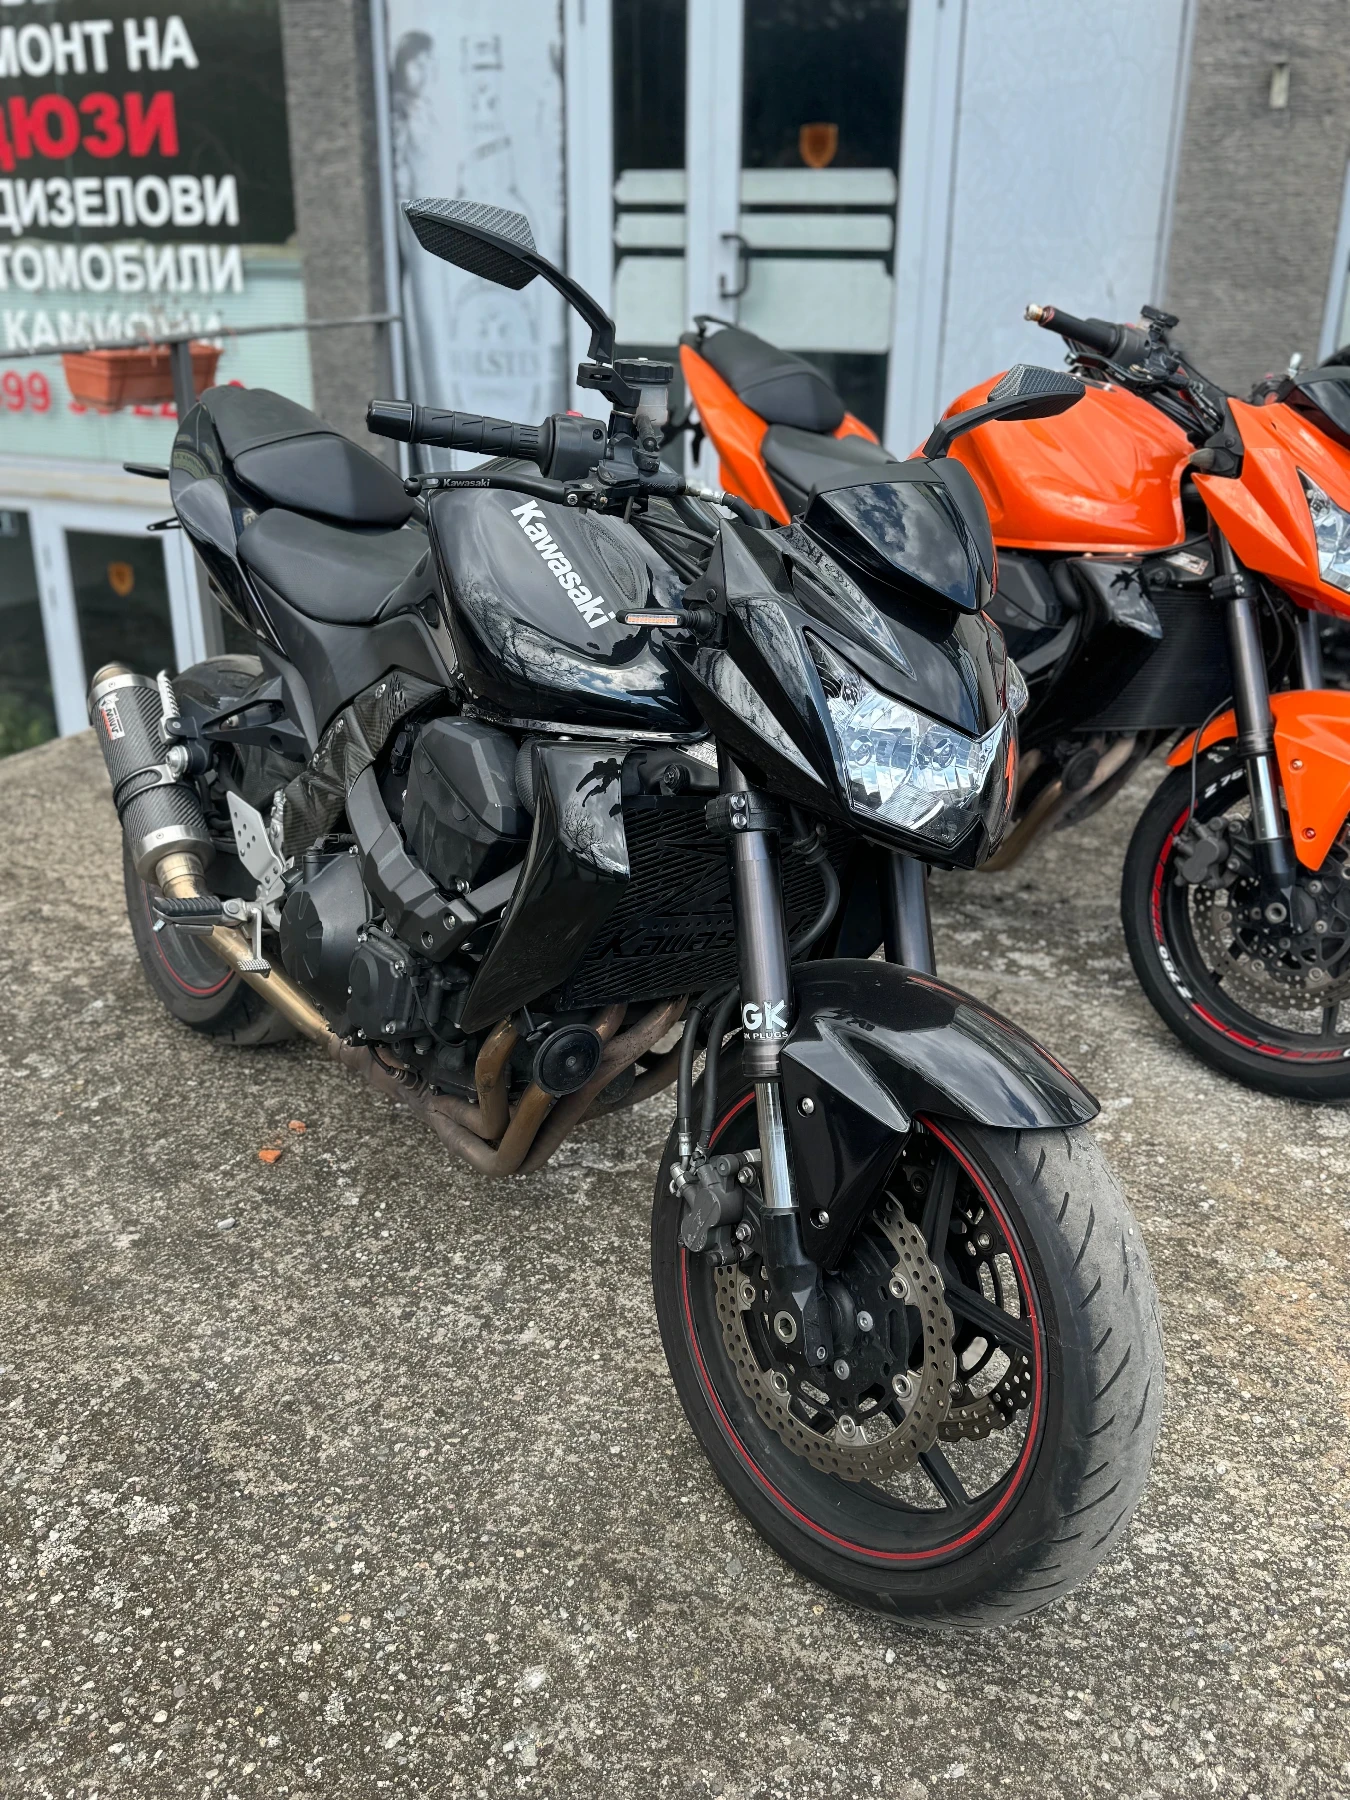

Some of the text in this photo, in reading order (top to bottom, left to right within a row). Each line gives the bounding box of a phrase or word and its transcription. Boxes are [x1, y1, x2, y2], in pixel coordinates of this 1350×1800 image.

[124, 16, 199, 71] НА
[443, 478, 491, 487] Kawasaki
[510, 499, 617, 629] Kawasaki
[741, 999, 788, 1030] GK
[752, 1031, 789, 1040] PLUGS
